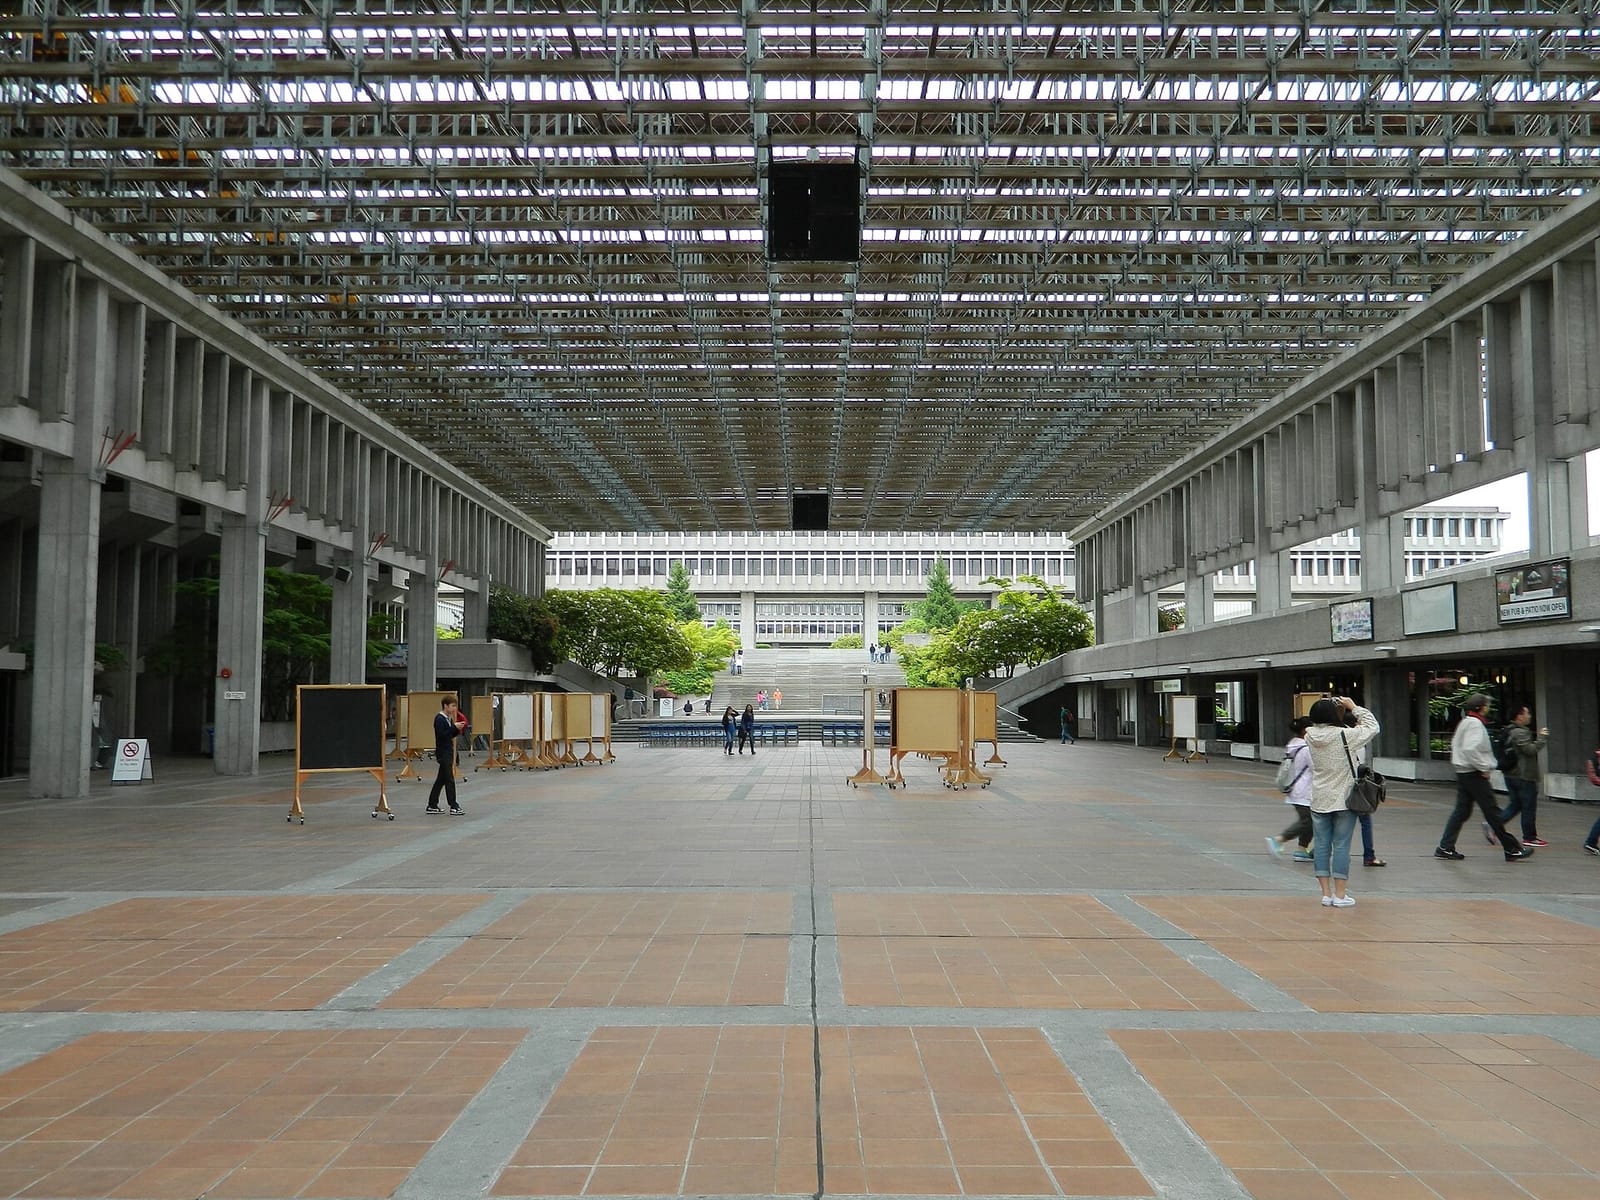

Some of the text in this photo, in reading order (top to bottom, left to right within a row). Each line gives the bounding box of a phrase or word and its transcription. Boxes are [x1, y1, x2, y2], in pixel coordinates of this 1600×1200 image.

[1511, 607, 1521, 617] PUB
[1525, 605, 1539, 615] PATIO
[1539, 603, 1551, 613] NOW
[1551, 602, 1565, 611] OPEN
